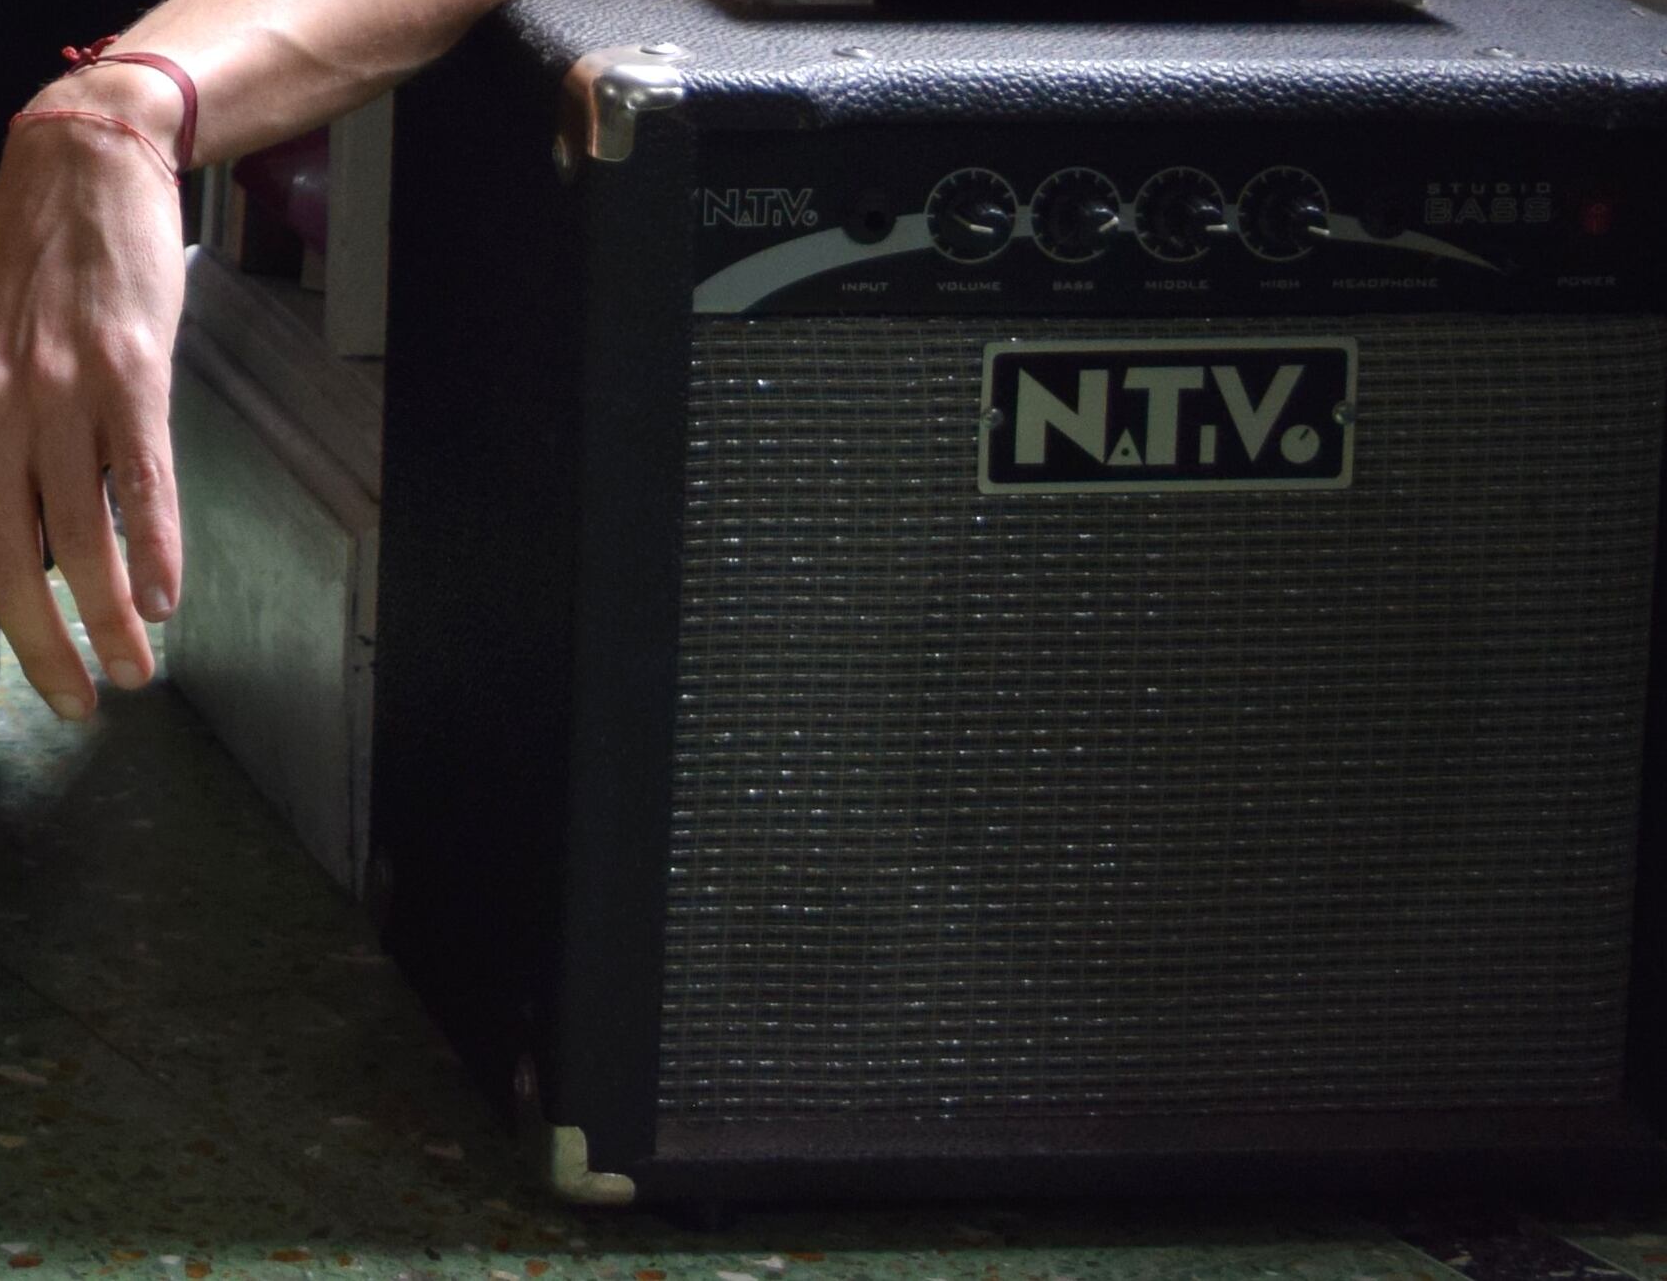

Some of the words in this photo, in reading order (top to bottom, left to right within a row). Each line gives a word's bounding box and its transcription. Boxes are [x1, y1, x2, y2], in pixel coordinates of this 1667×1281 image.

[1426, 182, 1552, 196] STUDIO
[1424, 196, 1552, 225] BASS
[841, 280, 890, 293] INPUT
[936, 280, 1002, 292] VOLUME
[1051, 280, 1095, 292] BASS
[1143, 279, 1210, 291] MIDDLE
[1258, 279, 1301, 290] HIGH
[1331, 277, 1440, 290] HEADPHONE
[1556, 275, 1618, 288] POWER
